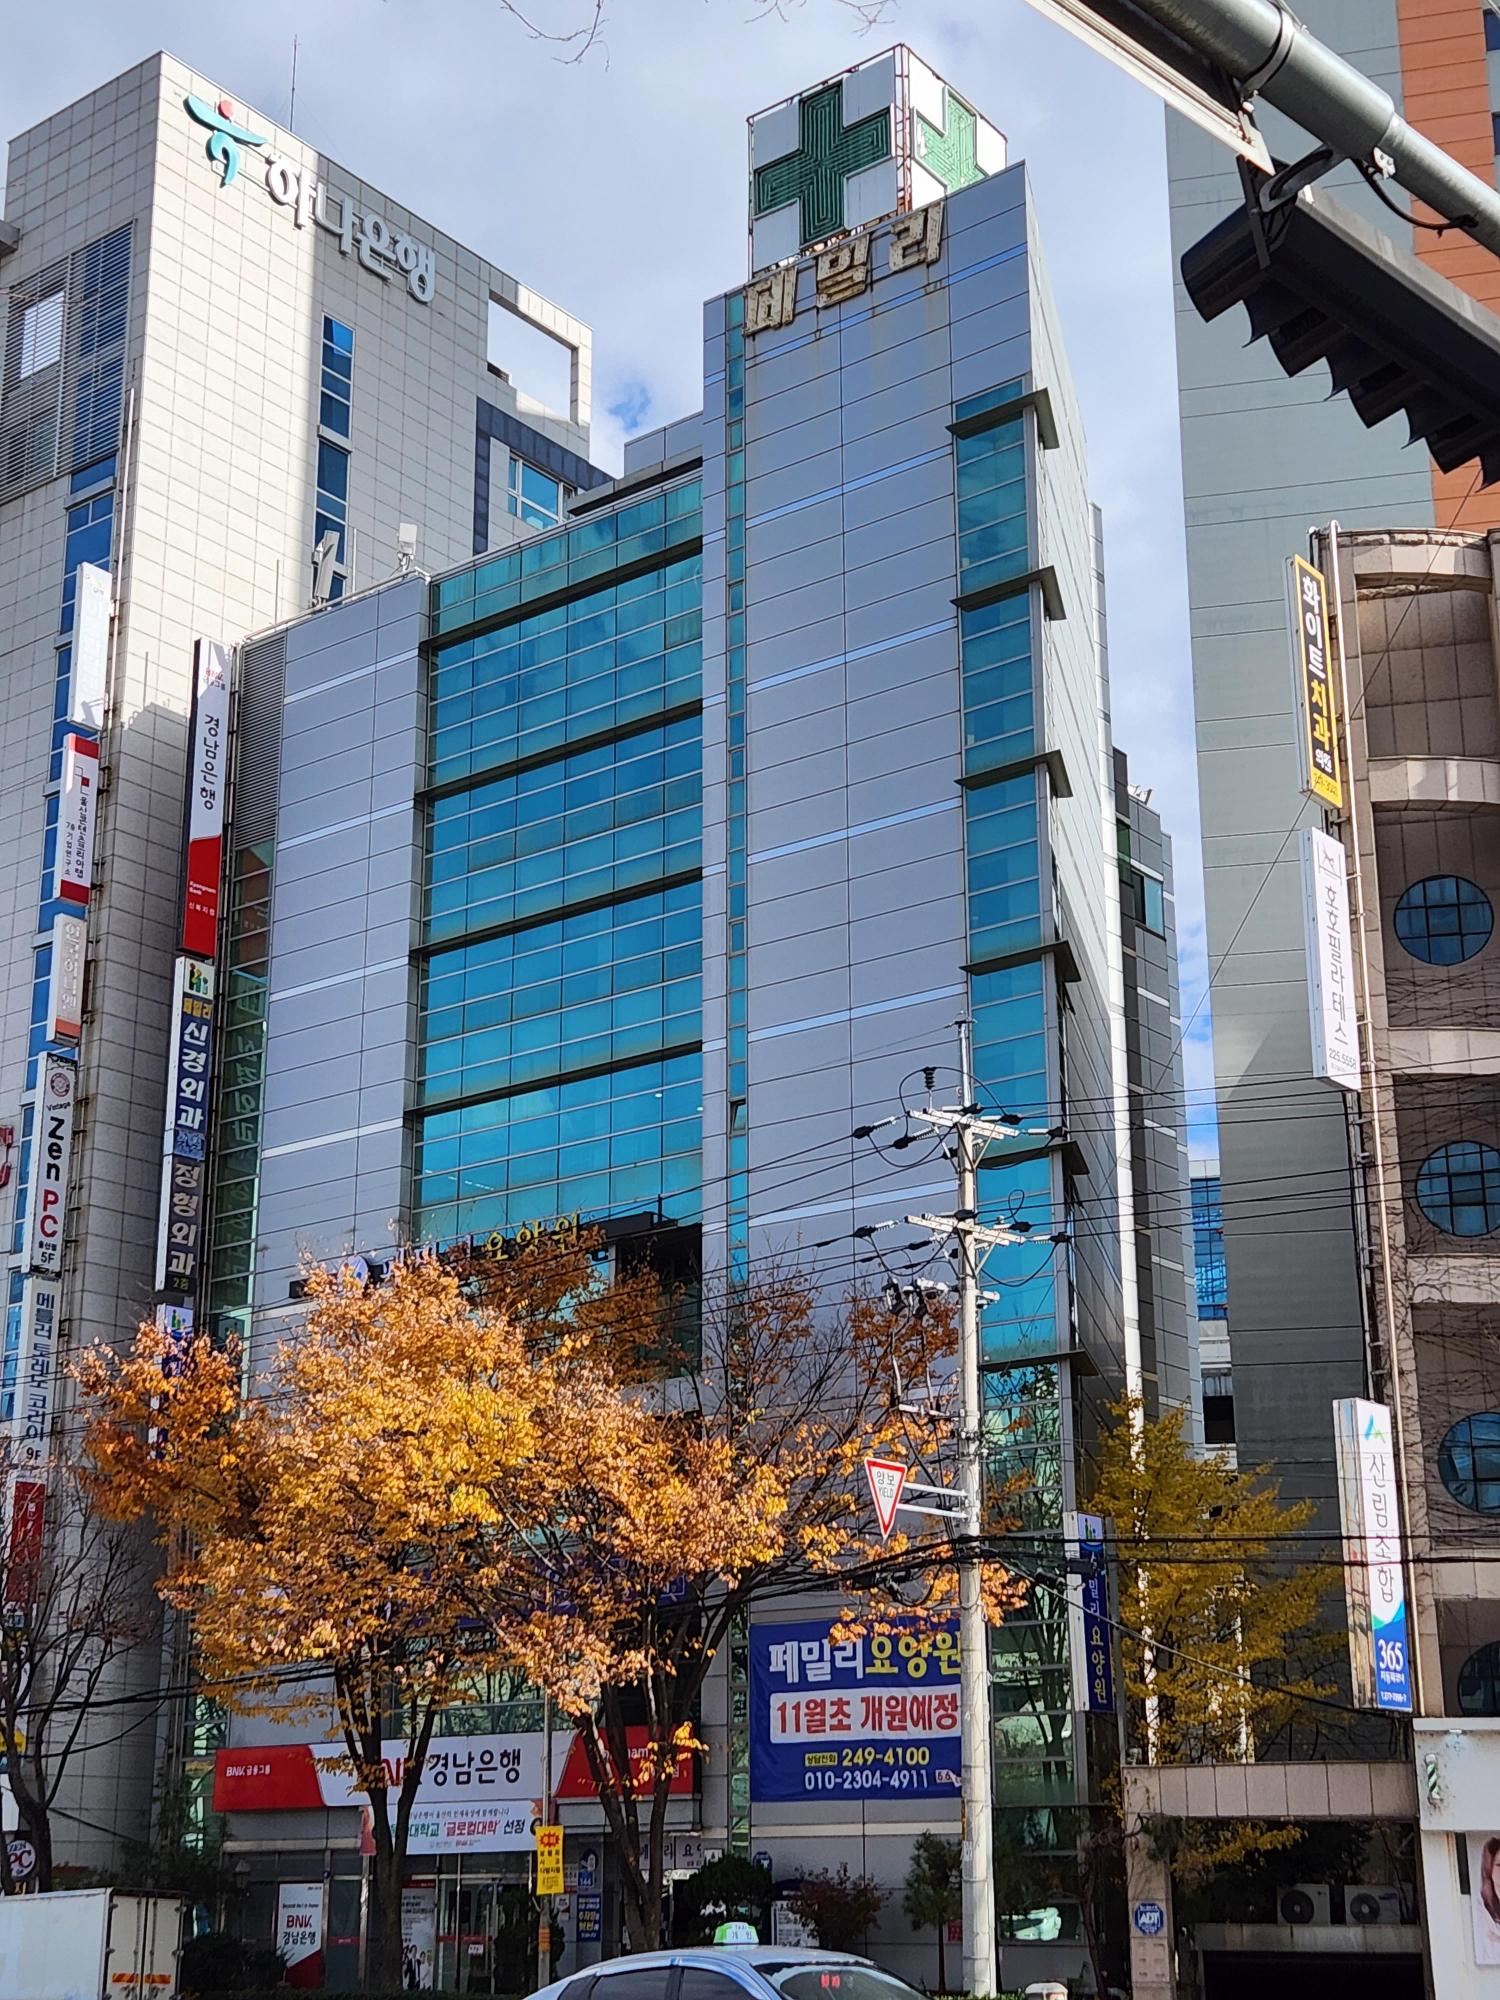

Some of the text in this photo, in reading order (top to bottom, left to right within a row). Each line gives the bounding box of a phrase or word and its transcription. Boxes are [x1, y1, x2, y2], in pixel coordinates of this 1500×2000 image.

[265, 152, 436, 303] 하나은행
[200, 714, 220, 810] 경남은행
[177, 1022, 209, 1131] 신경외과
[40, 1189, 59, 1238] PC
[168, 1164, 201, 1276] 정형외과
[41, 1252, 55, 1264] 5F
[26, 1447, 41, 1460] 9F
[877, 1471, 895, 1485] 양보
[879, 1487, 893, 1498] YIELD
[1370, 1454, 1394, 1603] 산림조합
[1378, 1639, 1404, 1672] 365
[777, 1692, 959, 1735] 11월초 개원예정
[428, 1748, 521, 1787] 경남은행
[842, 1747, 930, 1767] 249-4100
[805, 1769, 928, 1790] 010-2304-4911
[503, 1819, 525, 1835] 선정
[286, 1914, 313, 1929] BNK
[1139, 1911, 1158, 1926] ADT
[283, 1930, 317, 1946] 경남은행
